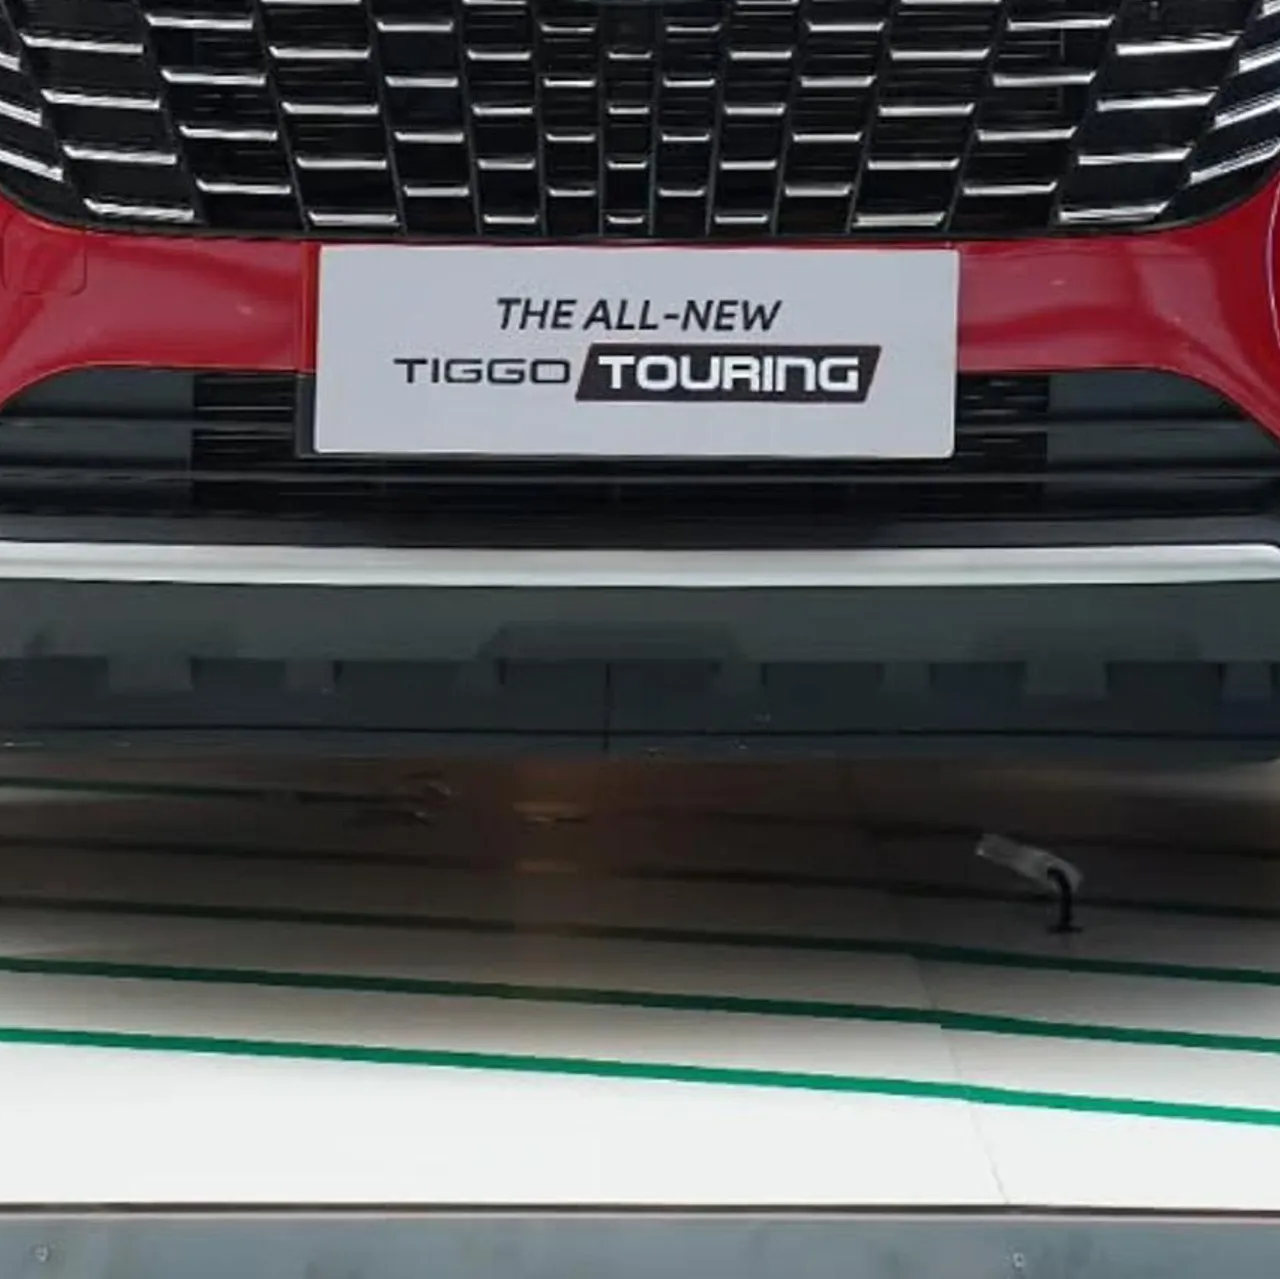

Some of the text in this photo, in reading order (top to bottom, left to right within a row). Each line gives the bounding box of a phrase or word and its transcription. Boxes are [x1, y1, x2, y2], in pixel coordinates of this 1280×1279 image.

[496, 297, 783, 333] THE ALL-NEW
[393, 354, 861, 394] TIGGO TOURING
